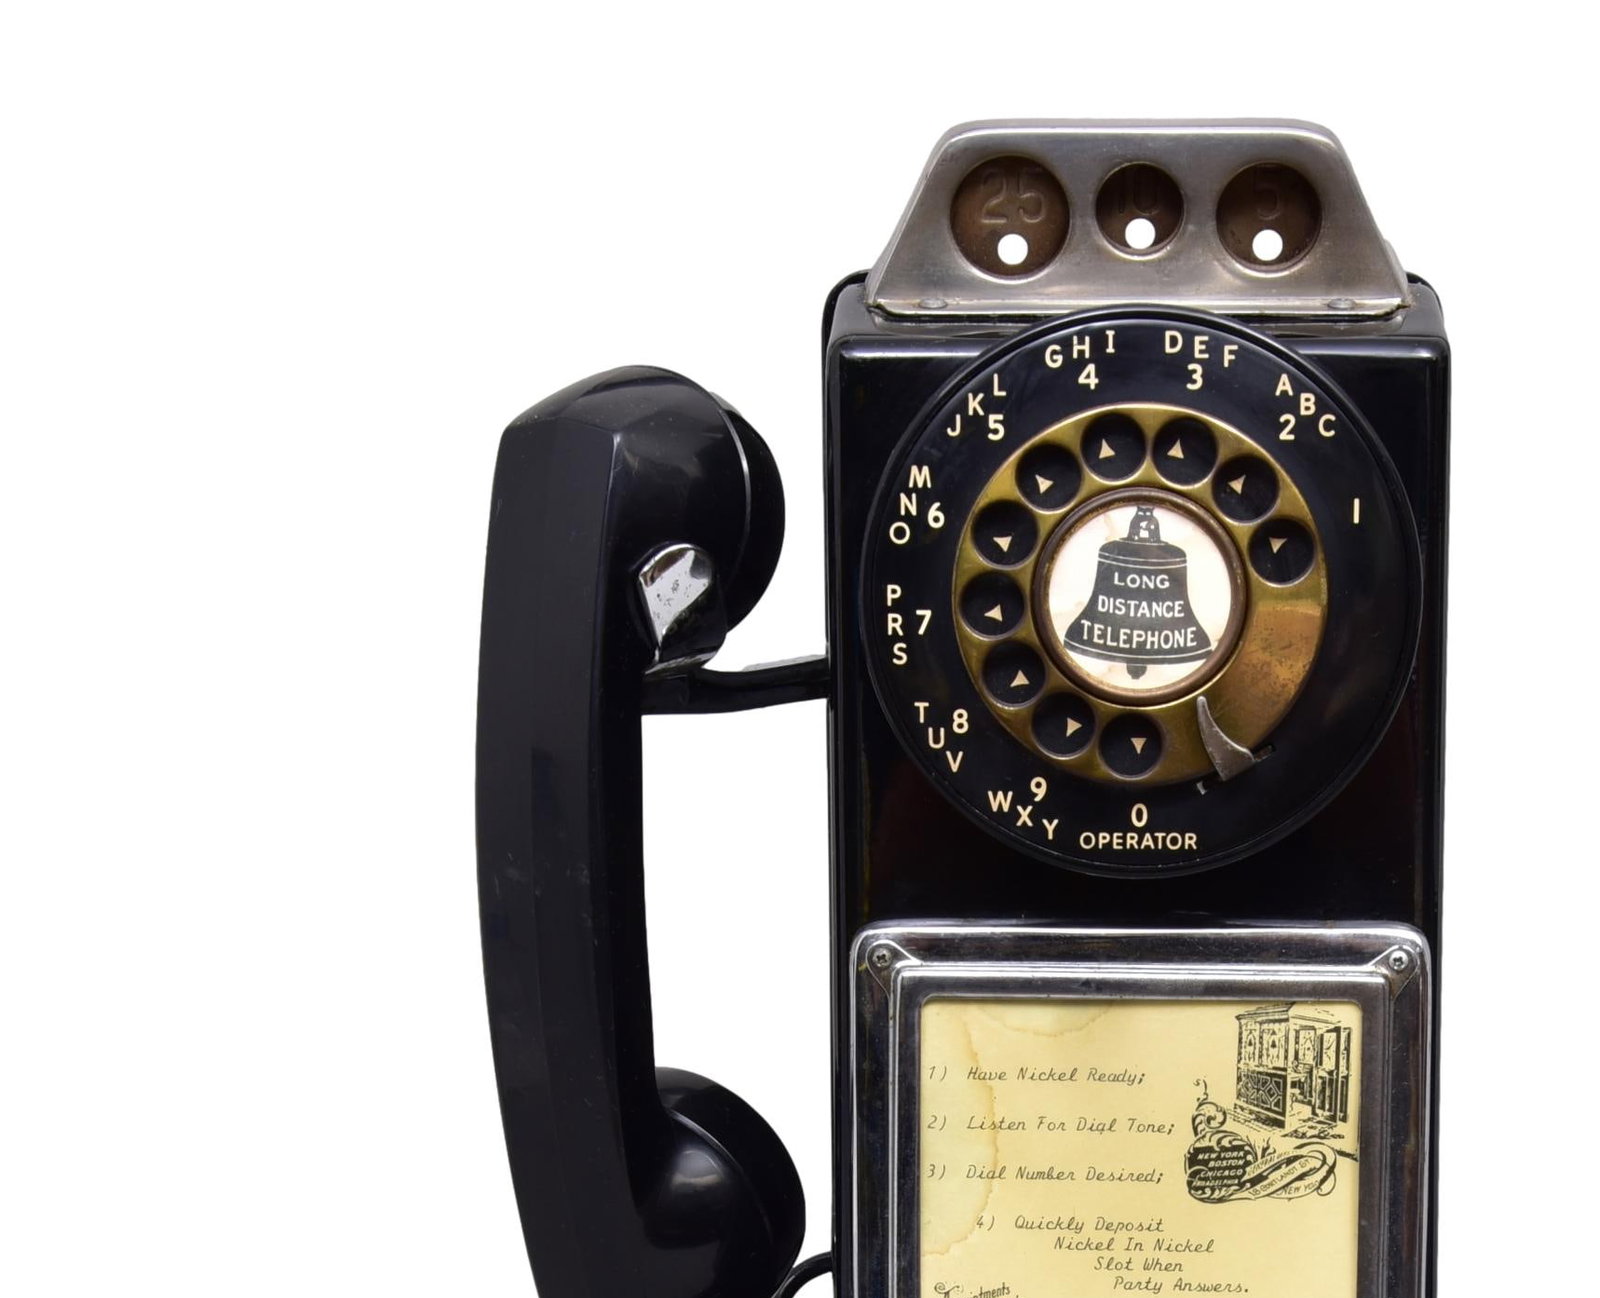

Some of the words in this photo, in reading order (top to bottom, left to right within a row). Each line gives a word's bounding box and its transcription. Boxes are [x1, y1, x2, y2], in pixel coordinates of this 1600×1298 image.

[979, 166, 1046, 224] 25
[1077, 363, 1099, 390] 4
[1186, 363, 1203, 391] 3
[987, 413, 1005, 441] 5
[1278, 413, 1296, 441] 2
[927, 501, 945, 529] 6
[1114, 571, 1171, 589] LONG
[1097, 595, 1185, 618] DISTANCE
[915, 609, 932, 635] 7
[1080, 619, 1198, 649] TELEPHONE
[952, 708, 969, 734] 8
[1030, 776, 1047, 802] 9
[1079, 832, 1197, 850] OPERATOR
[928, 1066, 947, 1082] 1)
[967, 1067, 1007, 1081] Have
[1017, 1067, 1078, 1082] Nickel
[1087, 1069, 1146, 1086] Ready;
[927, 1115, 946, 1131] 2)
[967, 1116, 1026, 1131] Listen
[1037, 1116, 1066, 1132] For
[1076, 1118, 1117, 1134] Dial
[1128, 1118, 1175, 1136] Tone;
[1197, 1152, 1219, 1160] NEW
[1220, 1150, 1245, 1159] YORK
[1208, 1159, 1245, 1168] BOSTON
[927, 1164, 946, 1180] 3)
[966, 1165, 1007, 1180] Dial
[1015, 1166, 1076, 1181] Number
[1085, 1166, 1164, 1185] Desired;
[1200, 1168, 1244, 1178] CHICAGO
[976, 1215, 996, 1231] 4)
[1014, 1216, 1085, 1234] Quickly
[1094, 1216, 1165, 1233] Deposit
[1054, 1236, 1115, 1252] Nickel
[1124, 1237, 1144, 1252] In
[1153, 1238, 1215, 1253] Nickel
[1094, 1256, 1133, 1272] Slot
[1143, 1257, 1184, 1273] When
[1113, 1276, 1163, 1295] Party
[1173, 1277, 1250, 1294] Answers.
